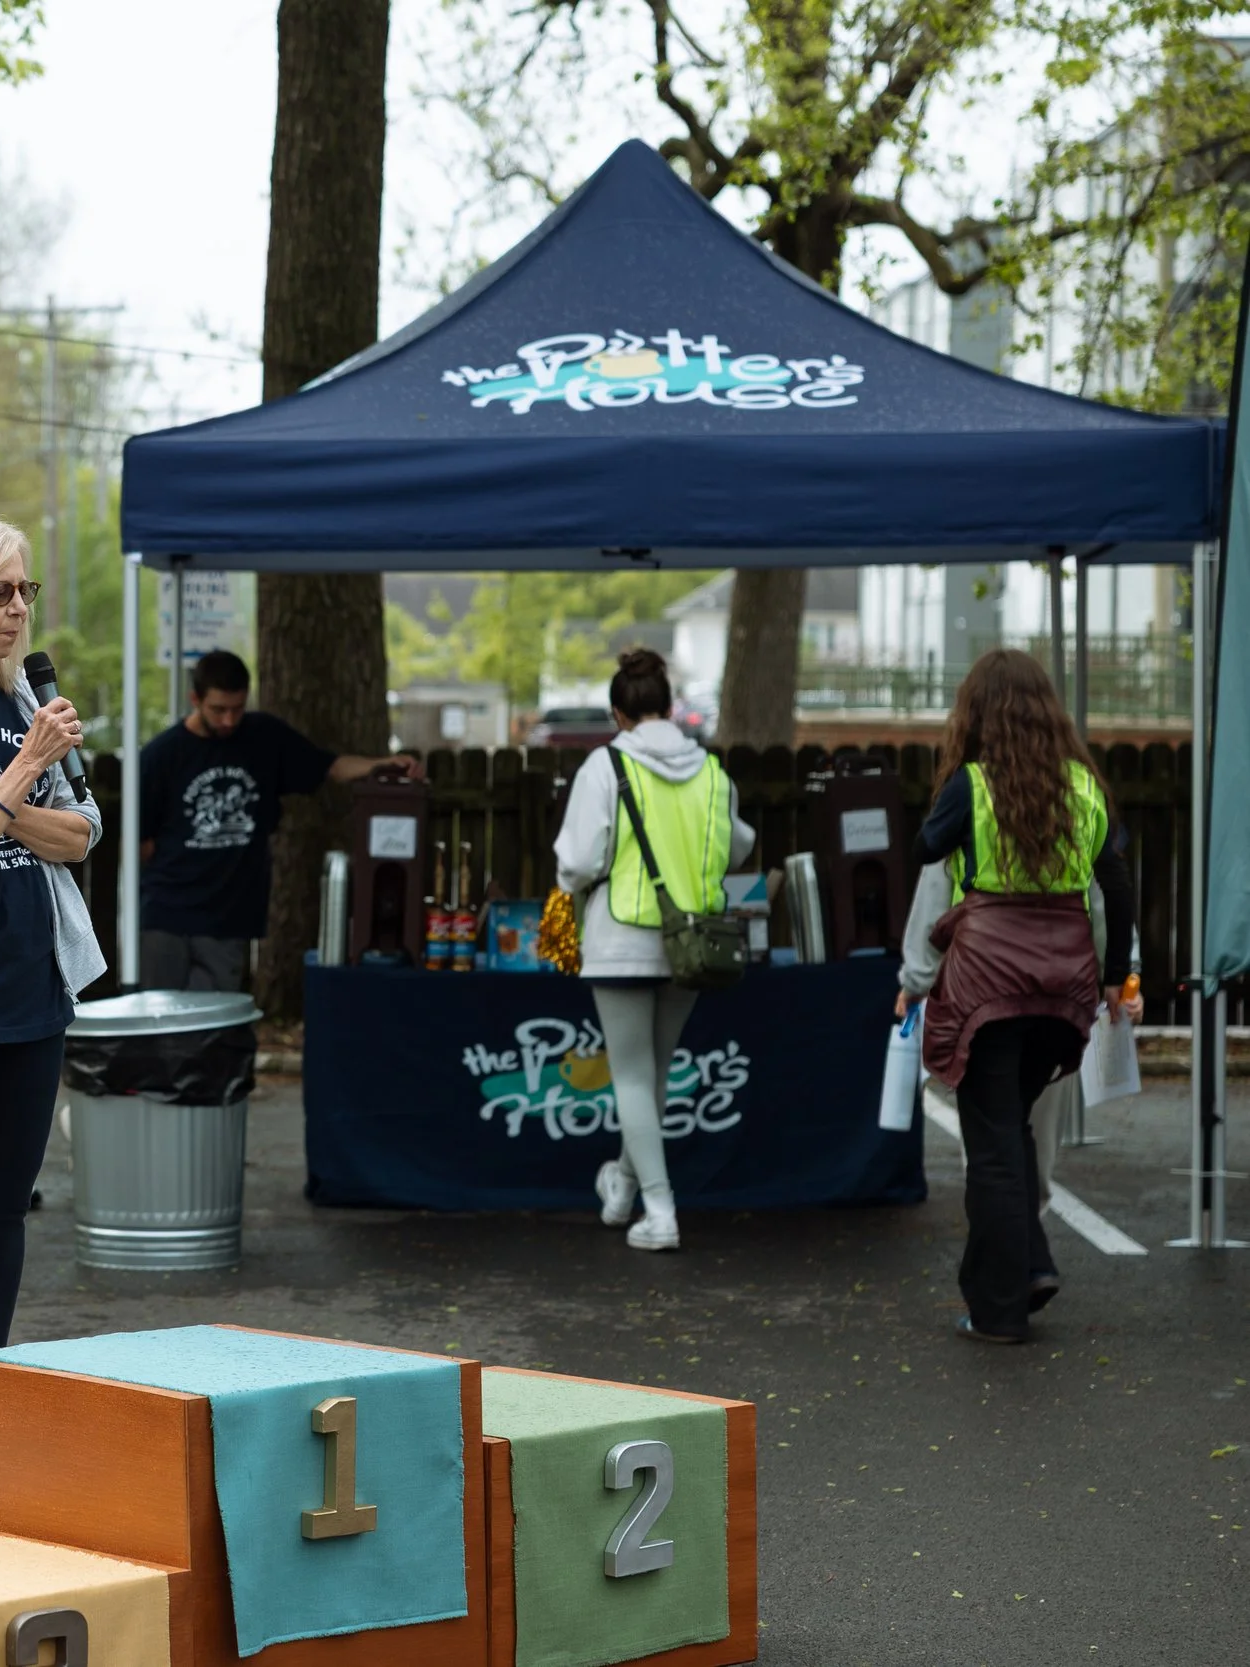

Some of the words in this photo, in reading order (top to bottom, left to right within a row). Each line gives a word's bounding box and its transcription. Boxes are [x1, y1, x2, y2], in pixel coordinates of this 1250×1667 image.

[441, 362, 524, 387] the
[470, 375, 859, 415] House
[462, 1043, 520, 1076] the
[515, 1017, 750, 1094] Poer's
[479, 1084, 743, 1140] Hose
[301, 1396, 378, 1540] 1
[603, 1439, 675, 1579] 2
